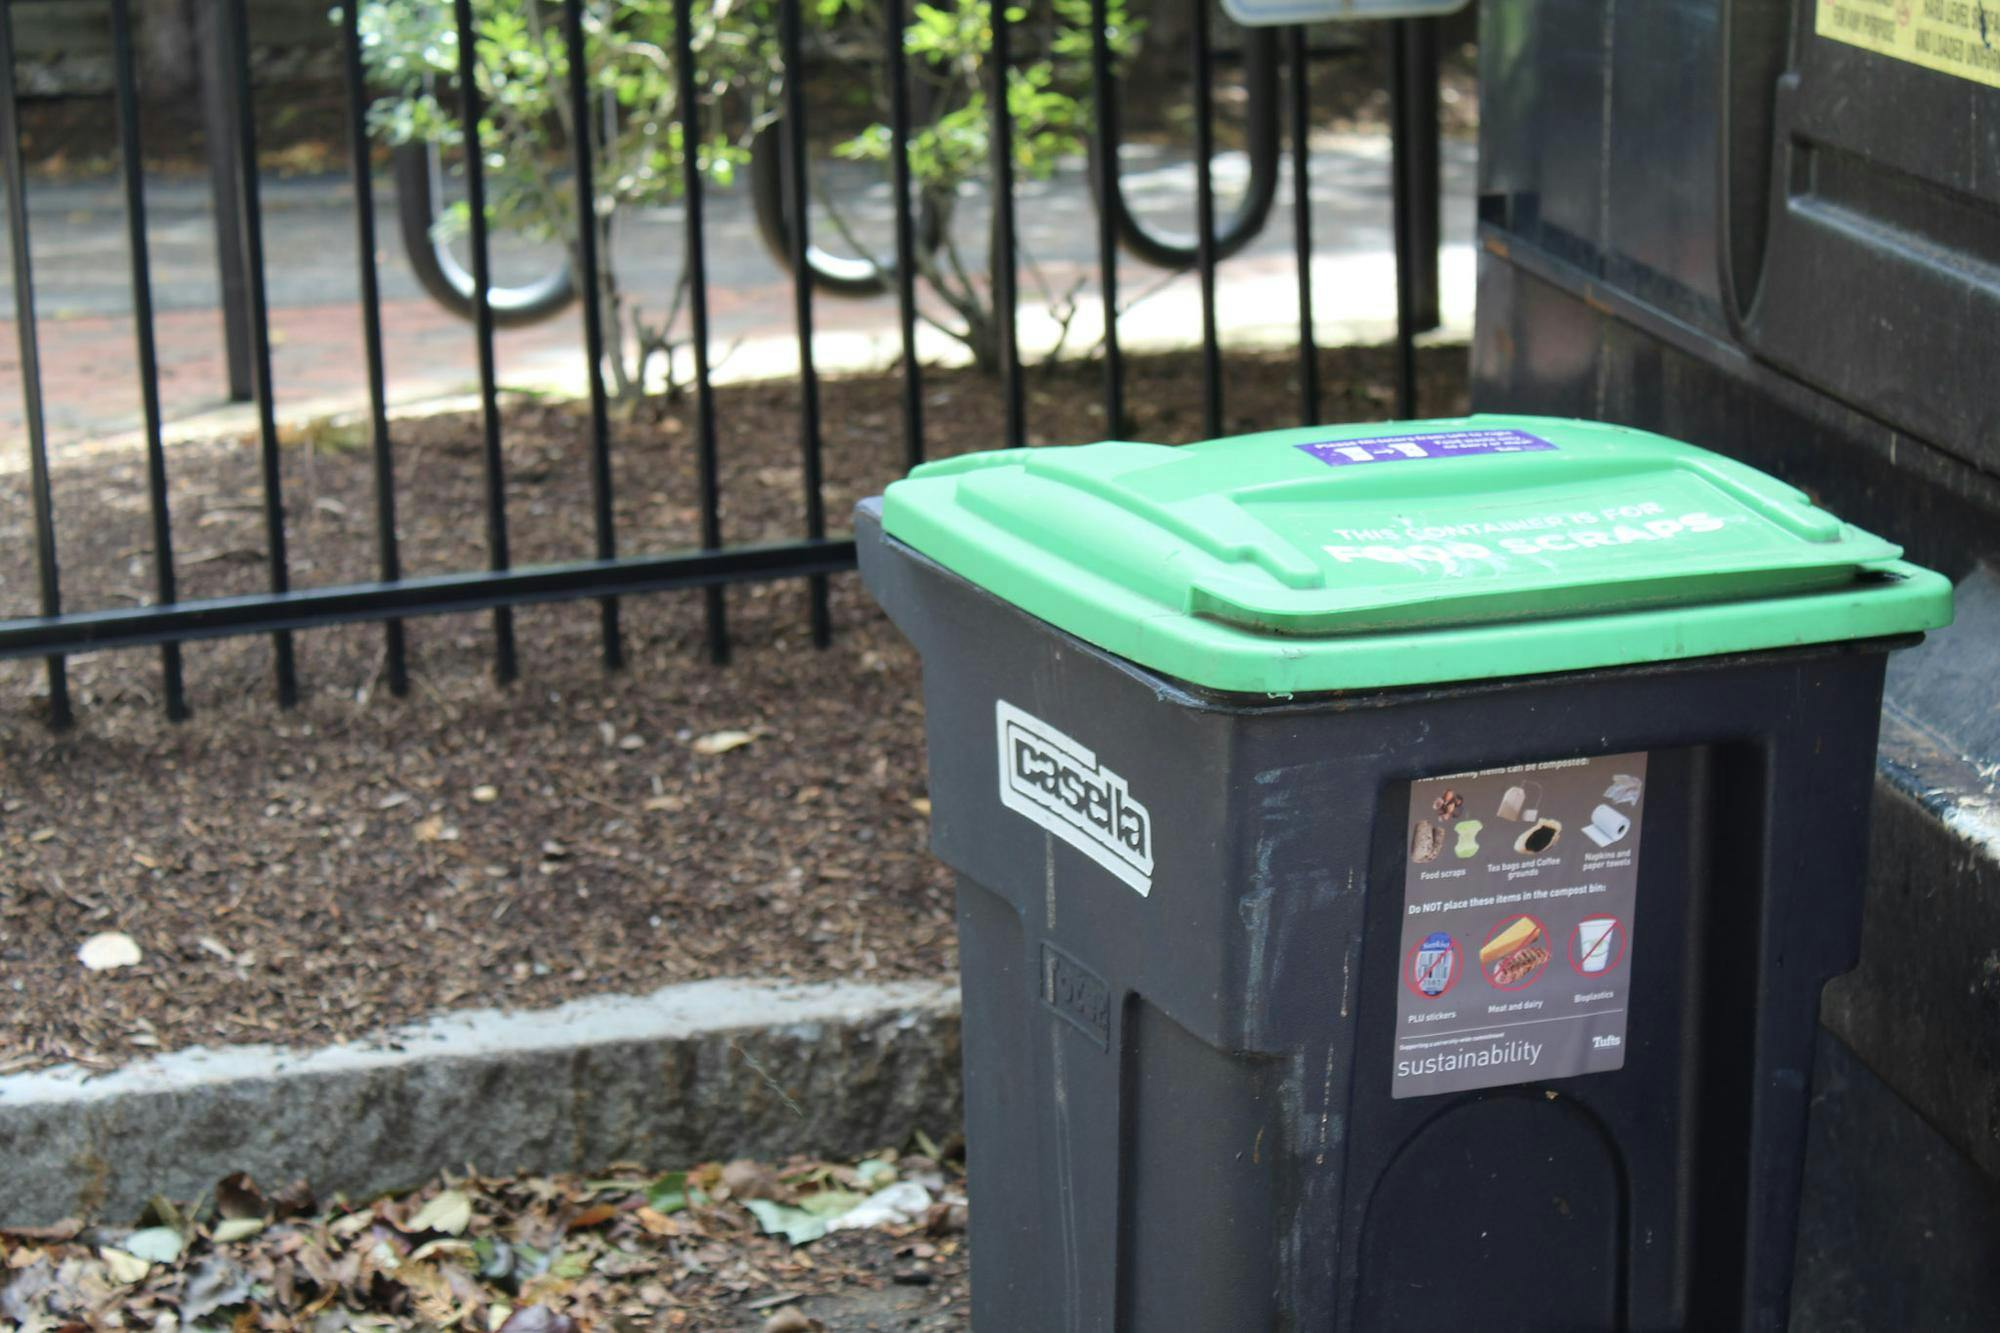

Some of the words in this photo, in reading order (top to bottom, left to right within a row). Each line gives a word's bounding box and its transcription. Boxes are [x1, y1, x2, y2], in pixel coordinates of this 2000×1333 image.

[1332, 528, 1400, 541] THIS
[1405, 514, 1567, 541] CONTAINER
[1570, 511, 1599, 525] IS
[1601, 502, 1665, 521] FOR
[1498, 512, 1725, 555] SCRAPS
[1014, 737, 1147, 859] casella
[1616, 849, 1631, 858] and
[1487, 863, 1500, 872] Tea
[1502, 861, 1520, 872] bags
[1521, 859, 1535, 868] and
[1537, 857, 1560, 867] Coffee
[1582, 861, 1605, 872] paper
[1420, 870, 1440, 880] Food
[1441, 868, 1466, 879] scraps
[1508, 868, 1539, 881] grounds
[1408, 904, 1421, 914] Do
[1423, 901, 1442, 913] NOT
[1443, 899, 1468, 913] place
[1470, 896, 1494, 907] these
[1496, 893, 1522, 904] items
[1523, 891, 1532, 901] in
[1533, 889, 1548, 899] the
[1550, 885, 1588, 898] compost
[1589, 883, 1606, 893] bin:
[1574, 991, 1614, 1003] Bioplastics
[1488, 1004, 1507, 1014] Meat
[1508, 1001, 1523, 1011] and
[1524, 999, 1543, 1010] dairy
[1408, 1014, 1425, 1024] PLU
[1426, 1010, 1456, 1022] stickers
[1592, 1034, 1621, 1048] Tufts
[1397, 1040, 1543, 1077] sustainability
